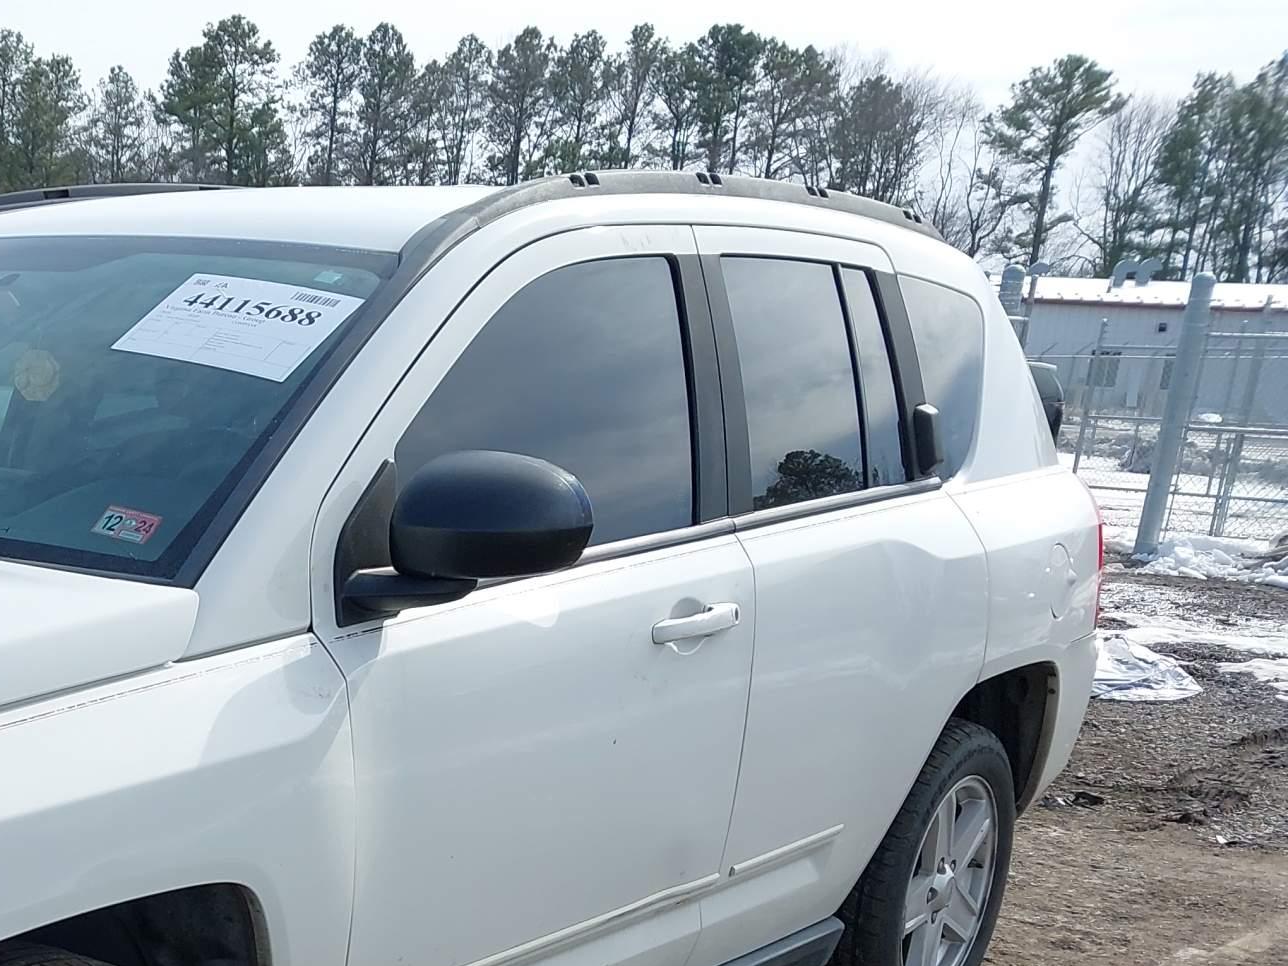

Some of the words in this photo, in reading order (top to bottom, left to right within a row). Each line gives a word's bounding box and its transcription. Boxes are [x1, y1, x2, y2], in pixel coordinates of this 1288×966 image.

[183, 292, 322, 327] 44115688
[101, 513, 124, 532] 12
[134, 520, 155, 534] 24
